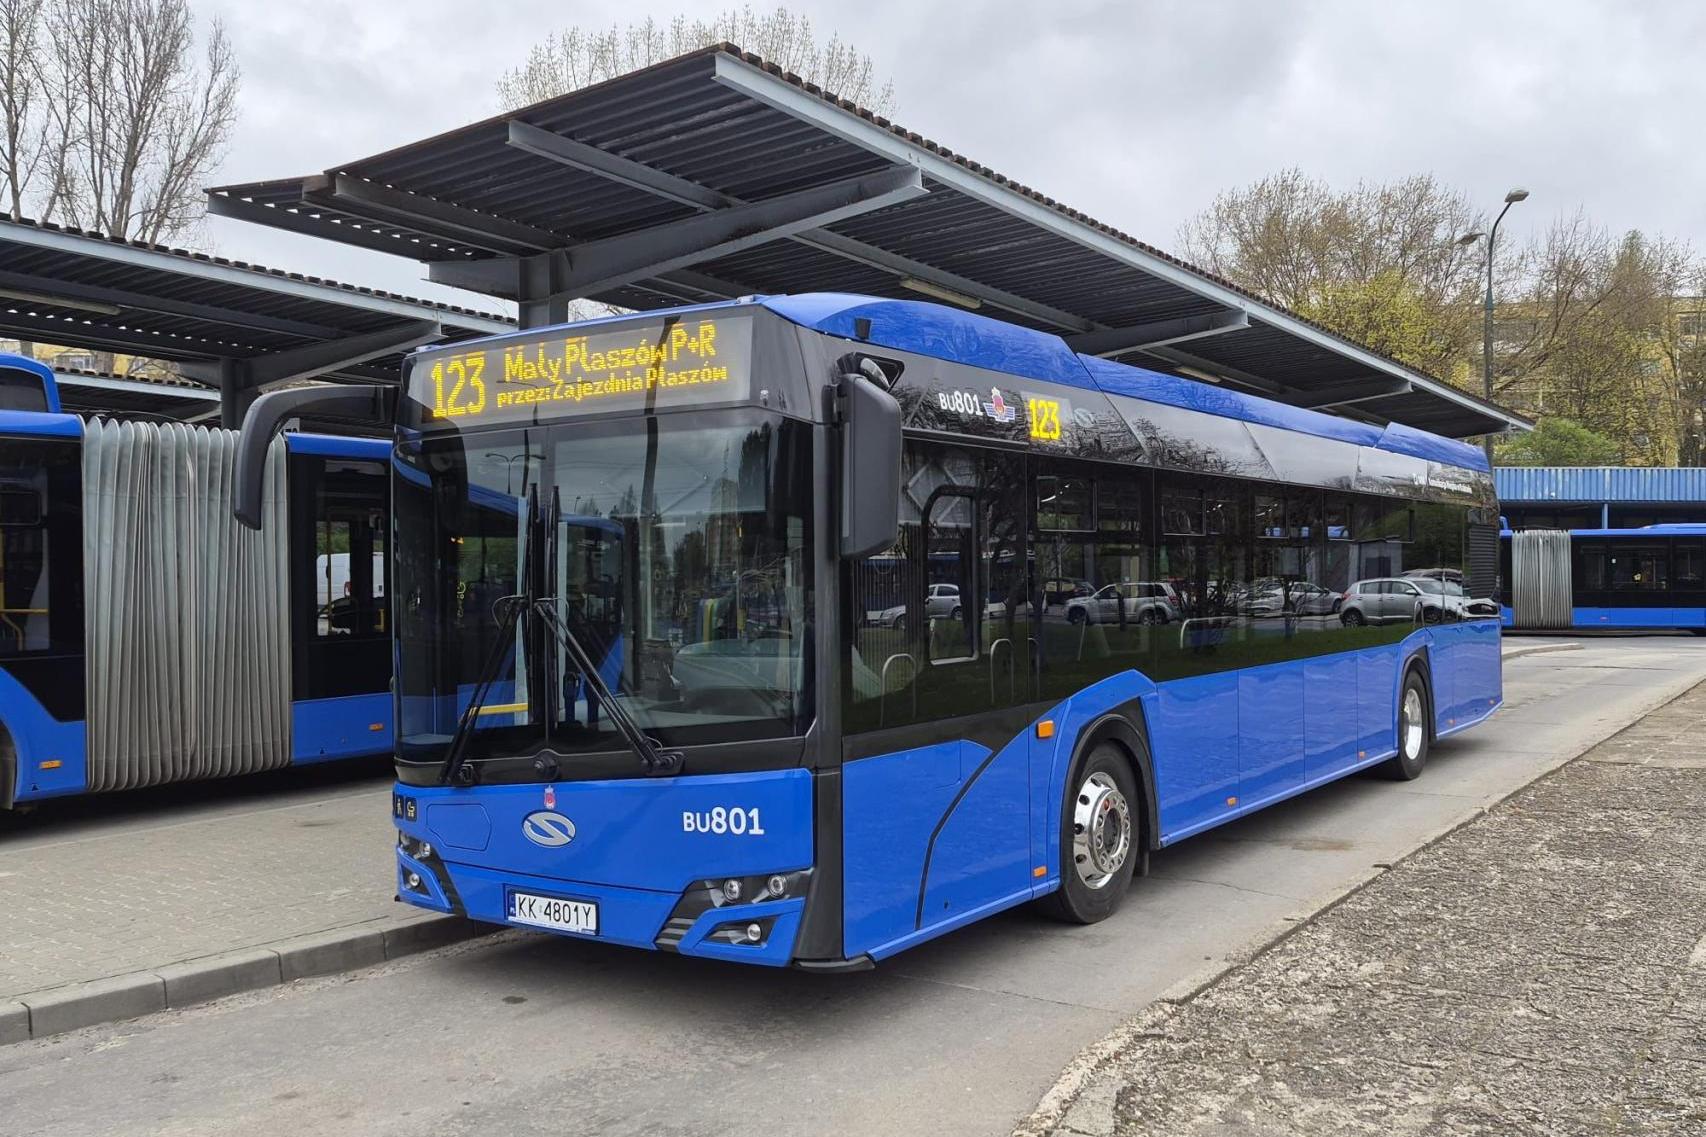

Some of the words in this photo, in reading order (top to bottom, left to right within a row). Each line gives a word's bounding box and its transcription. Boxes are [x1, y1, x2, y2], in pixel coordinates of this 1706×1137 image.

[671, 323, 716, 361] P+R
[431, 361, 485, 417] 123
[552, 371, 643, 400] Zajezdnia
[938, 391, 984, 416] BU801
[1029, 398, 1061, 441] 123
[683, 806, 765, 835] BU801
[543, 900, 591, 927] 4801Y
